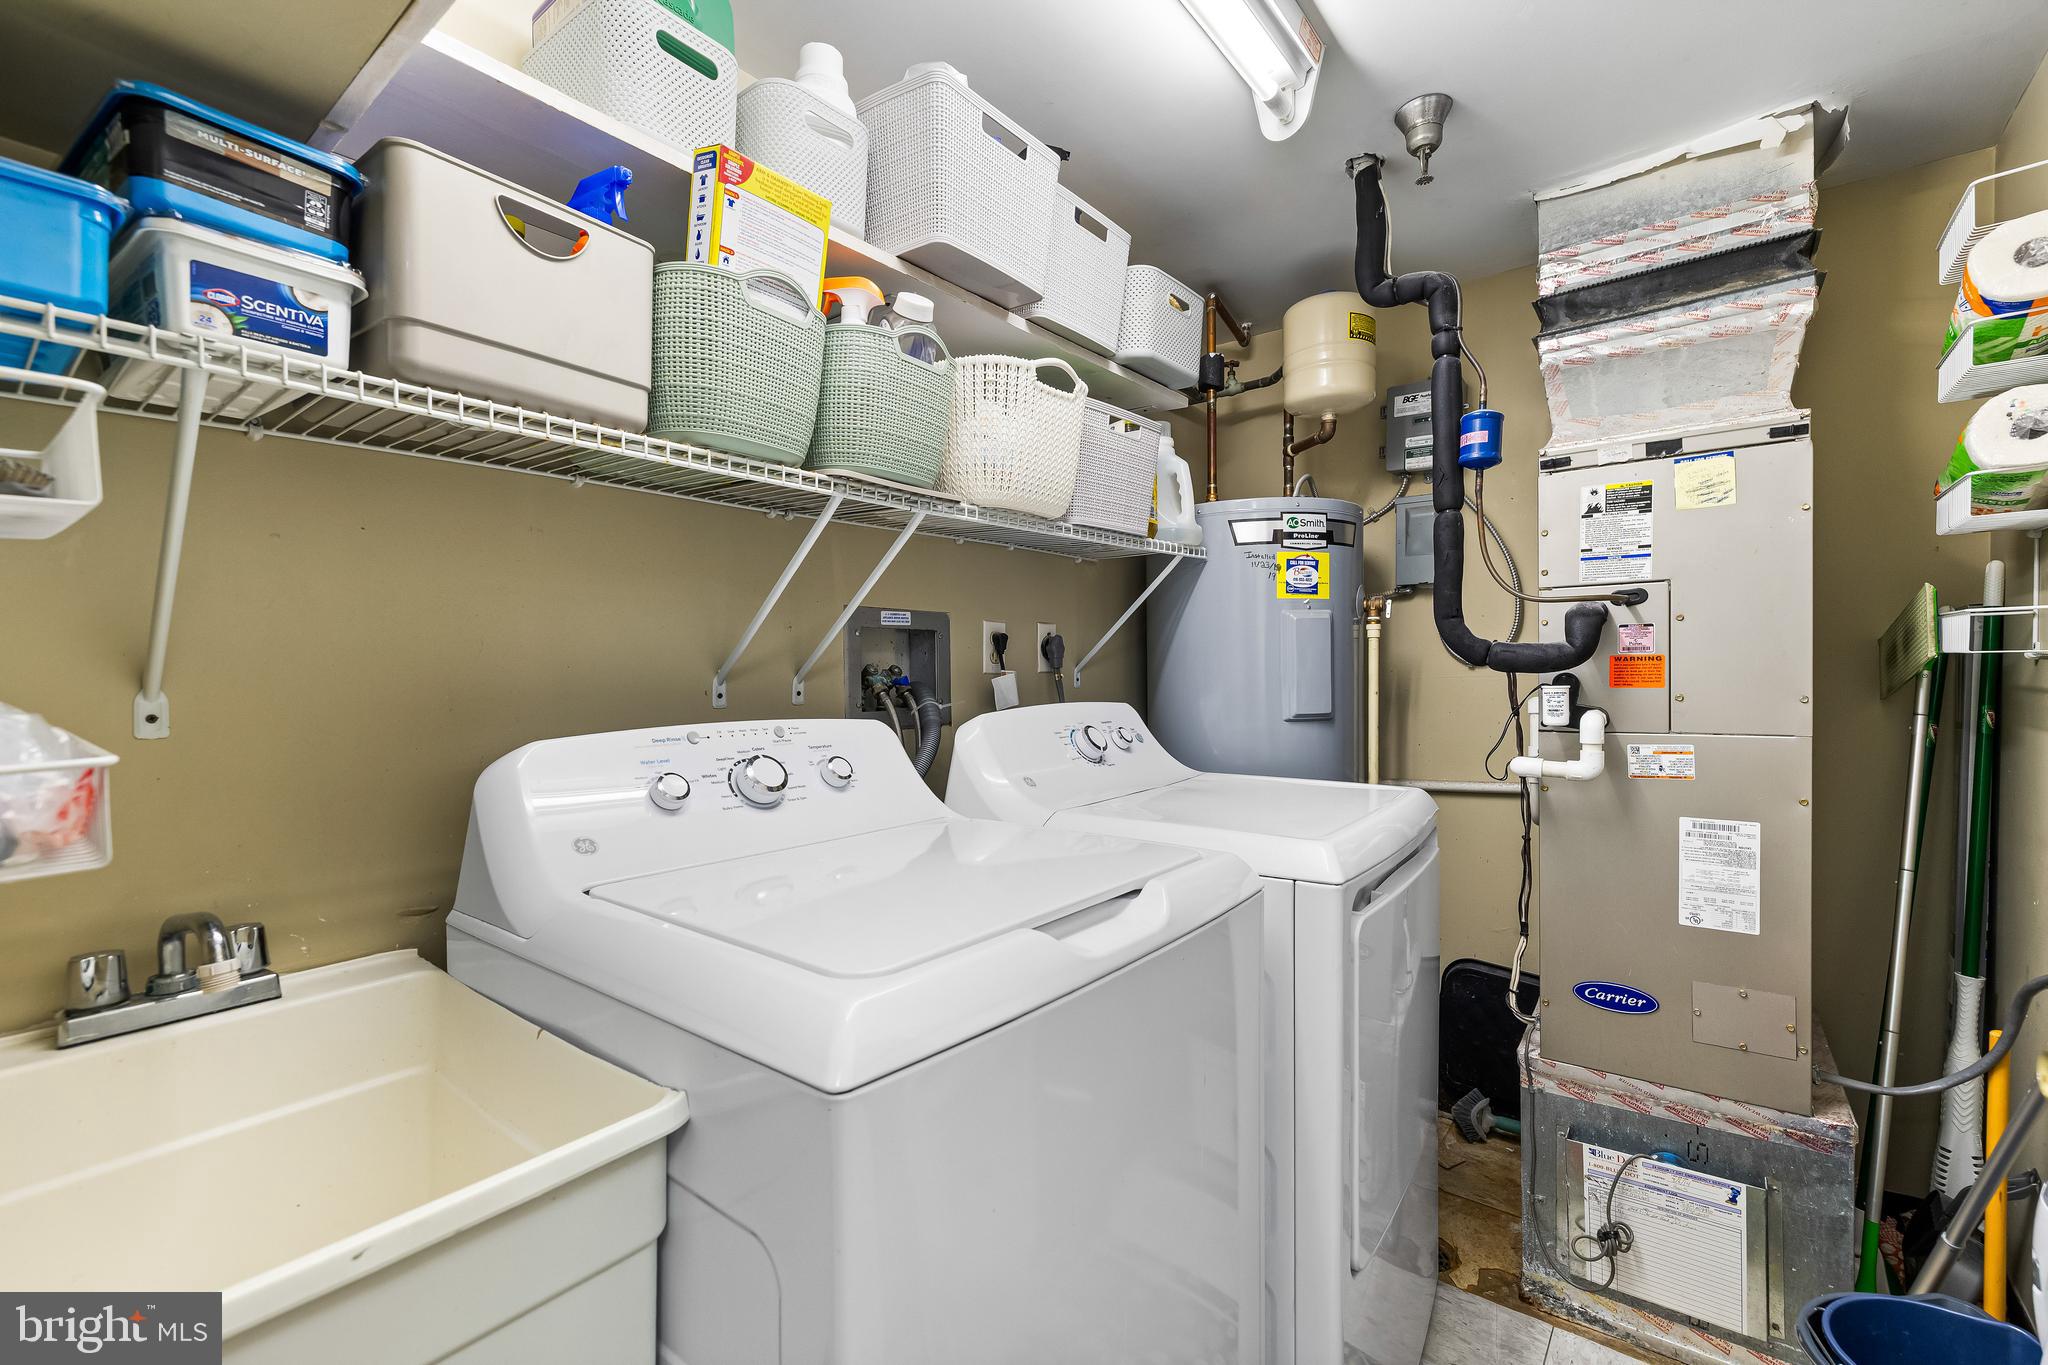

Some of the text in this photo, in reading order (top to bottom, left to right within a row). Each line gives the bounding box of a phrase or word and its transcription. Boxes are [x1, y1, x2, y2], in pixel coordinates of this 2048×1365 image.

[198, 130, 302, 176] MULTI-SURFACE
[241, 295, 325, 328] SCENTIVA
[200, 314, 212, 323] 24
[1403, 394, 1420, 403] BGE
[1300, 519, 1325, 528] Smith
[1584, 987, 1647, 1007] Carrier
[1594, 1149, 1615, 1161] Blue
